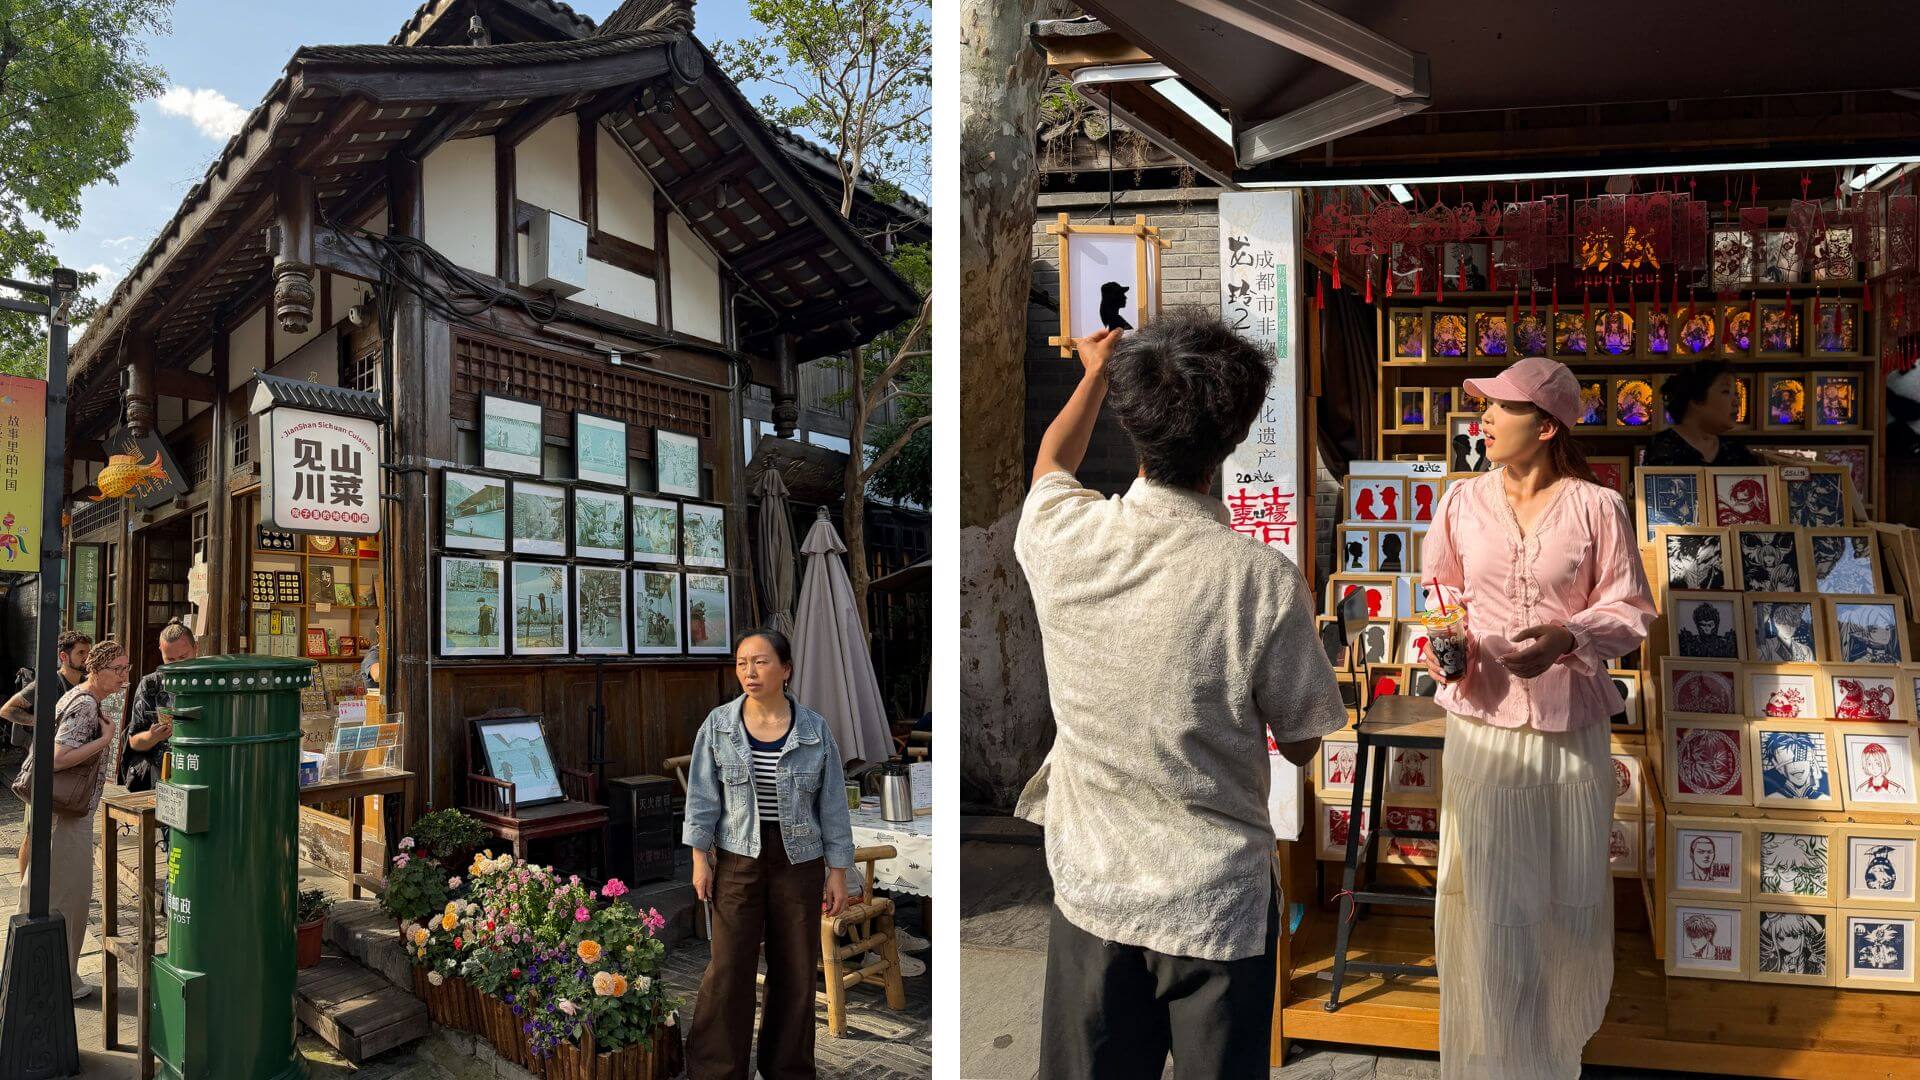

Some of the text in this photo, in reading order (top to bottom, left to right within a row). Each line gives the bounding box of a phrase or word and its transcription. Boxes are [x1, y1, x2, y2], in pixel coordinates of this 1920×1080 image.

[6, 415, 19, 491] 故事里的中国
[284, 421, 371, 452] JianShan Sichuan Cuisine
[293, 437, 361, 476] 见山
[292, 471, 363, 507] 川菜
[174, 913, 191, 925] POST
